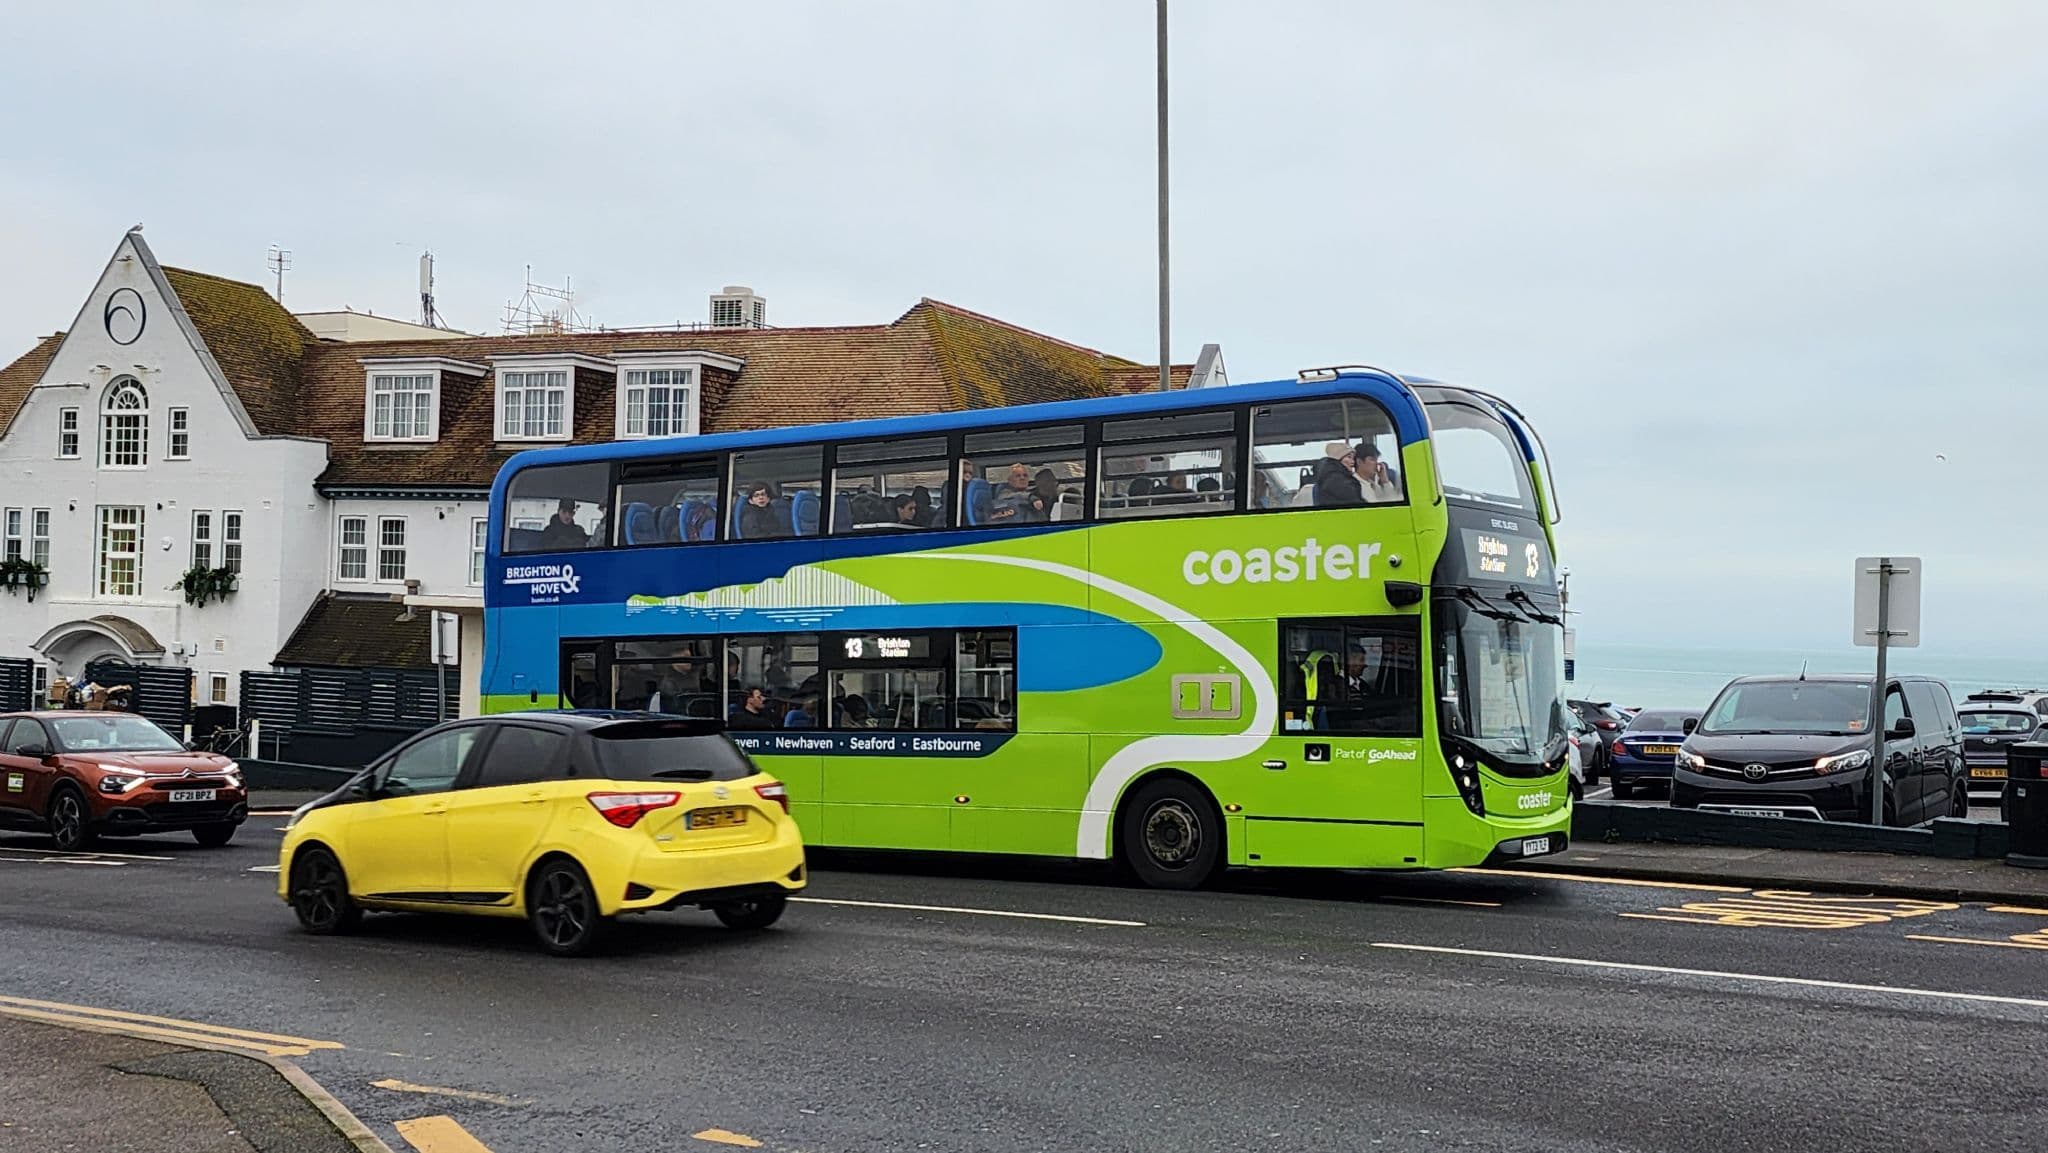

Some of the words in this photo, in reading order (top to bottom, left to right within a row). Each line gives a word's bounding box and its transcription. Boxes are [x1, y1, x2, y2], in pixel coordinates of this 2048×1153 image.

[1183, 537, 1381, 585] coaster
[1478, 535, 1508, 556] Brighton
[1525, 543, 1539, 578] 13
[1480, 556, 1506, 573] Station
[506, 564, 560, 578] BRIGHTON
[560, 564, 581, 593] &
[531, 583, 560, 594] HOVE
[845, 637, 862, 658] 13
[877, 637, 911, 649] Brighton
[880, 648, 908, 658] Station
[775, 736, 833, 749] Newhaven
[850, 736, 895, 750] Seaford
[912, 737, 982, 751] Eastbourne
[1335, 748, 1356, 759] Part
[1355, 748, 1366, 759] of
[1368, 749, 1416, 761] GoAhead
[174, 791, 195, 801] CF21
[195, 790, 212, 800] BPZ
[1518, 790, 1551, 810] coaster
